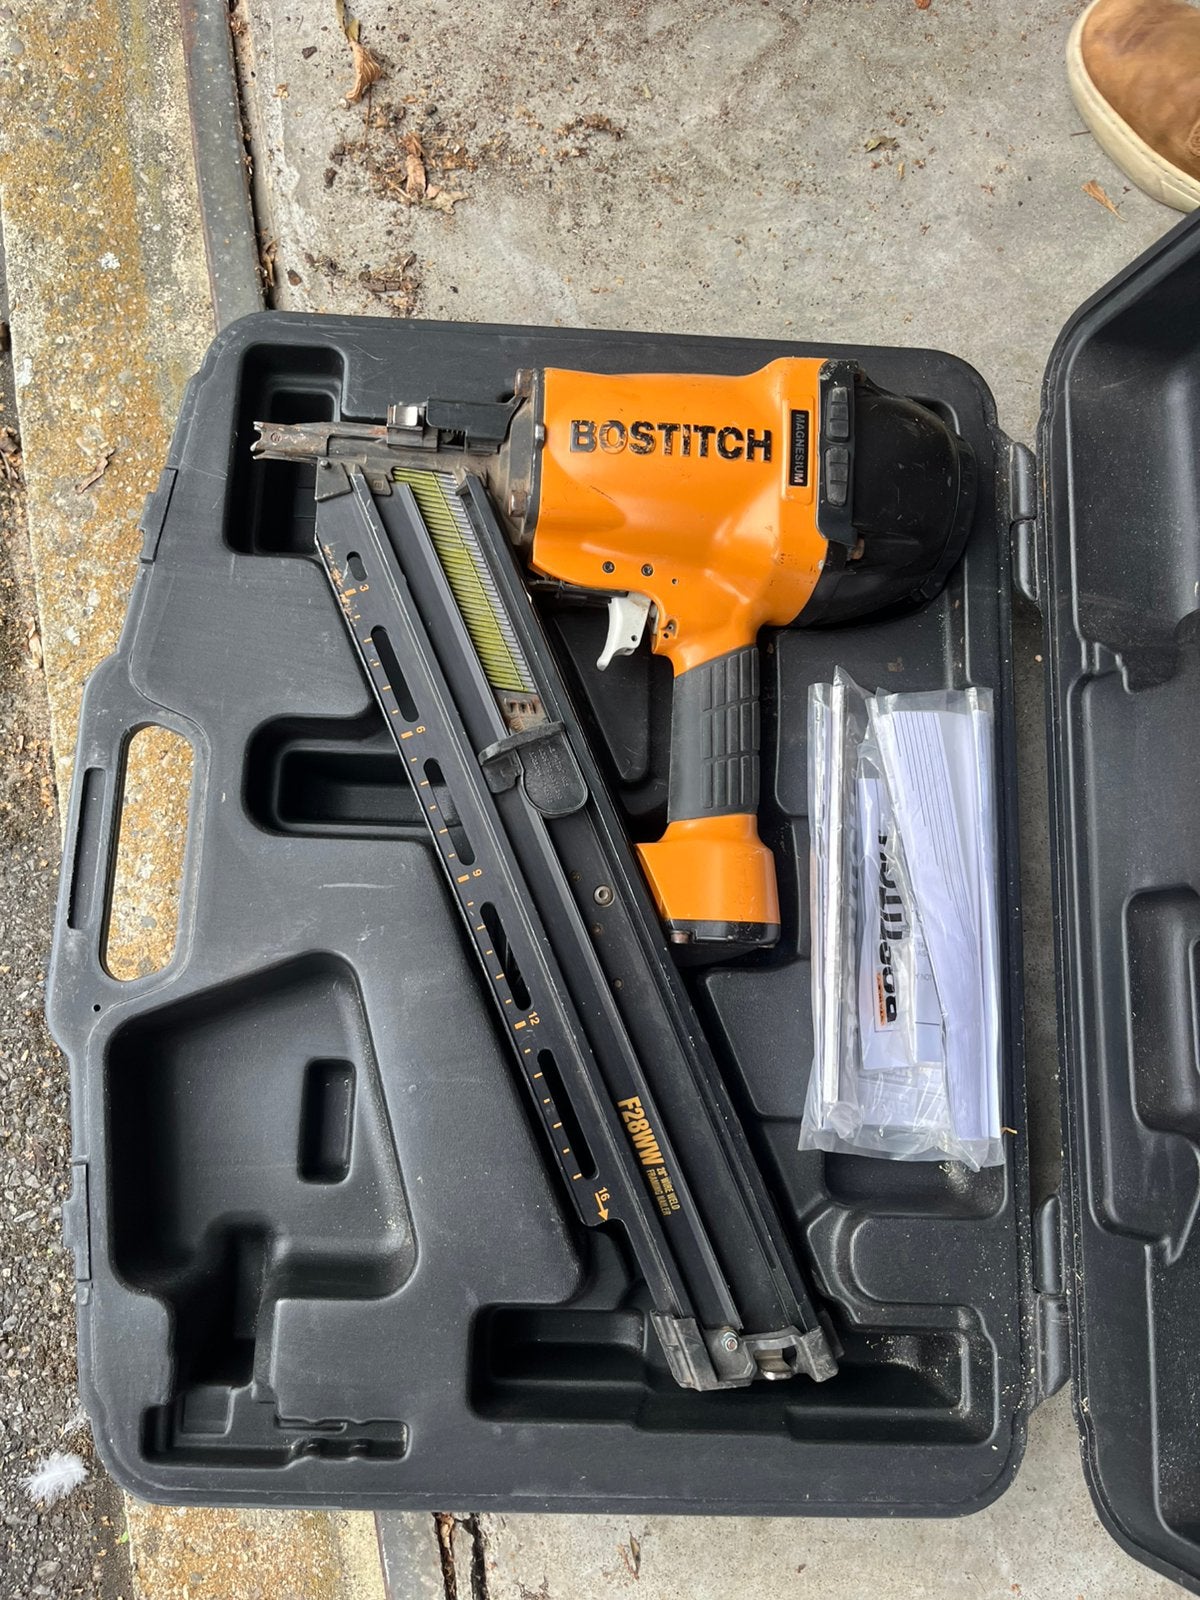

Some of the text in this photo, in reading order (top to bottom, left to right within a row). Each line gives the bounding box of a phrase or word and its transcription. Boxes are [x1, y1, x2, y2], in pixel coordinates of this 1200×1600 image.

[569, 419, 772, 463] BOSTITCH
[792, 413, 806, 484] MAGNESIUM
[359, 583, 370, 593] 3
[415, 725, 426, 734] 6
[472, 868, 483, 878] 9
[527, 1010, 541, 1027] 12
[617, 1095, 665, 1166] F28WW
[597, 1186, 611, 1202] 16
[667, 1192, 681, 1210] WELD
[656, 1195, 672, 1217] NAILER
